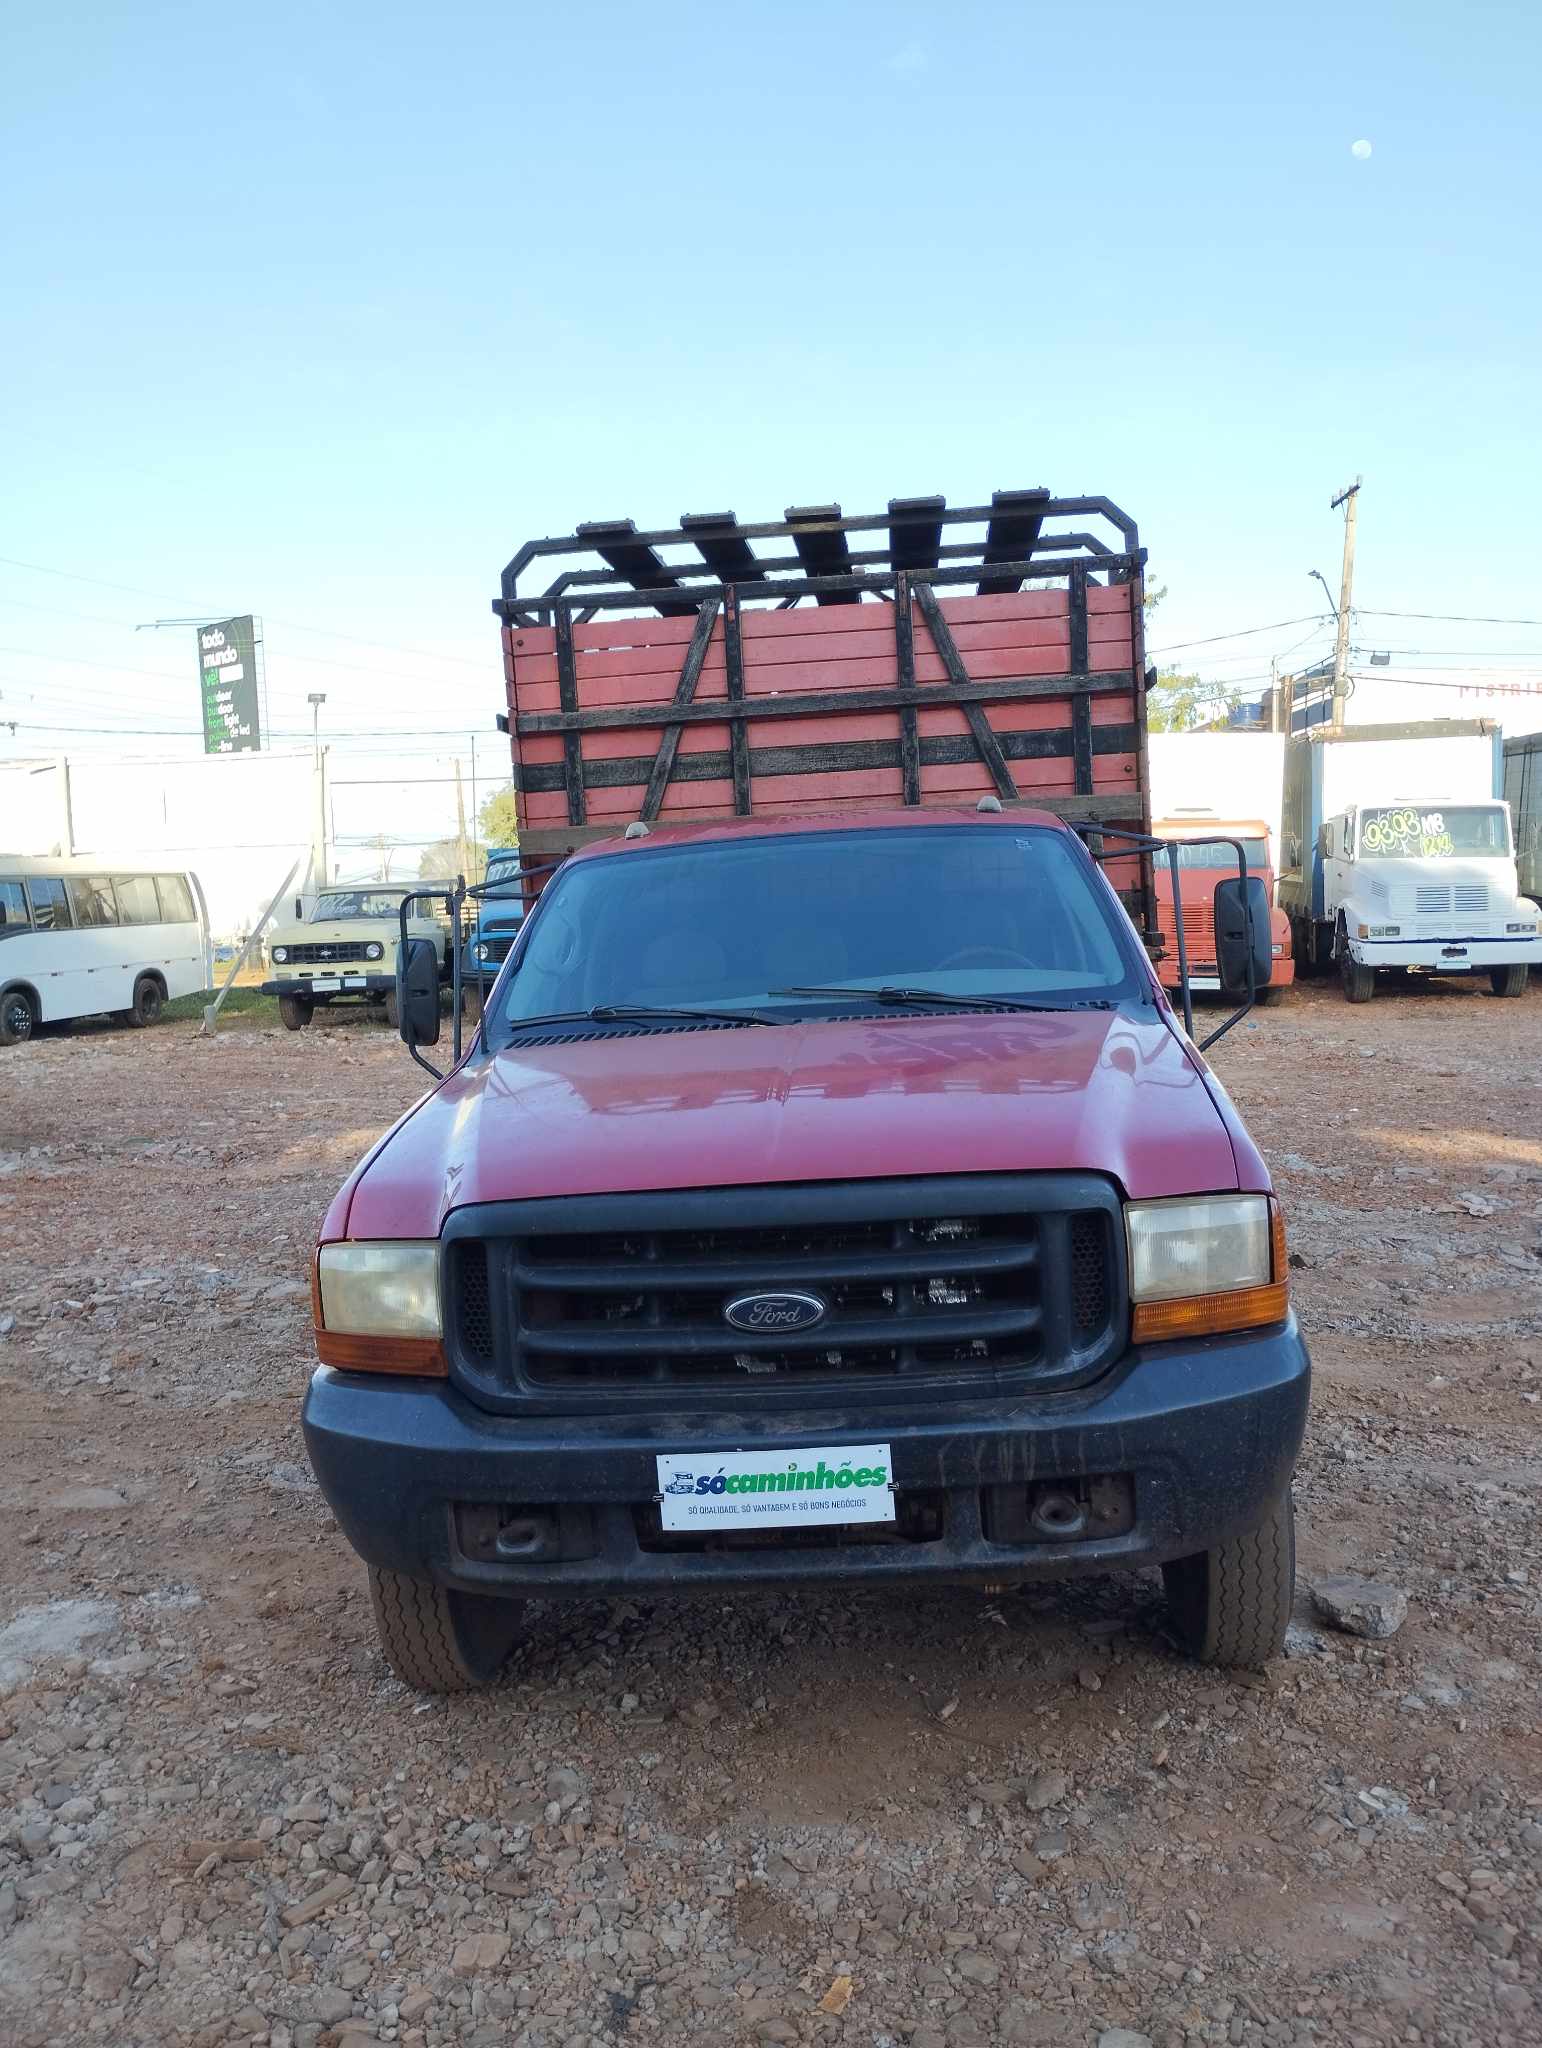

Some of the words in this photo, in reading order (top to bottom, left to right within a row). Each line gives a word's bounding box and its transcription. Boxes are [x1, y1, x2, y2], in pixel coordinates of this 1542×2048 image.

[201, 629, 224, 650] todo
[203, 645, 237, 668] mundo
[748, 1301, 801, 1324] Ford
[753, 1502, 790, 1513] VANTAGEM
[810, 1501, 829, 1511] BONS
[831, 1498, 867, 1510] NEGÓCIOS
